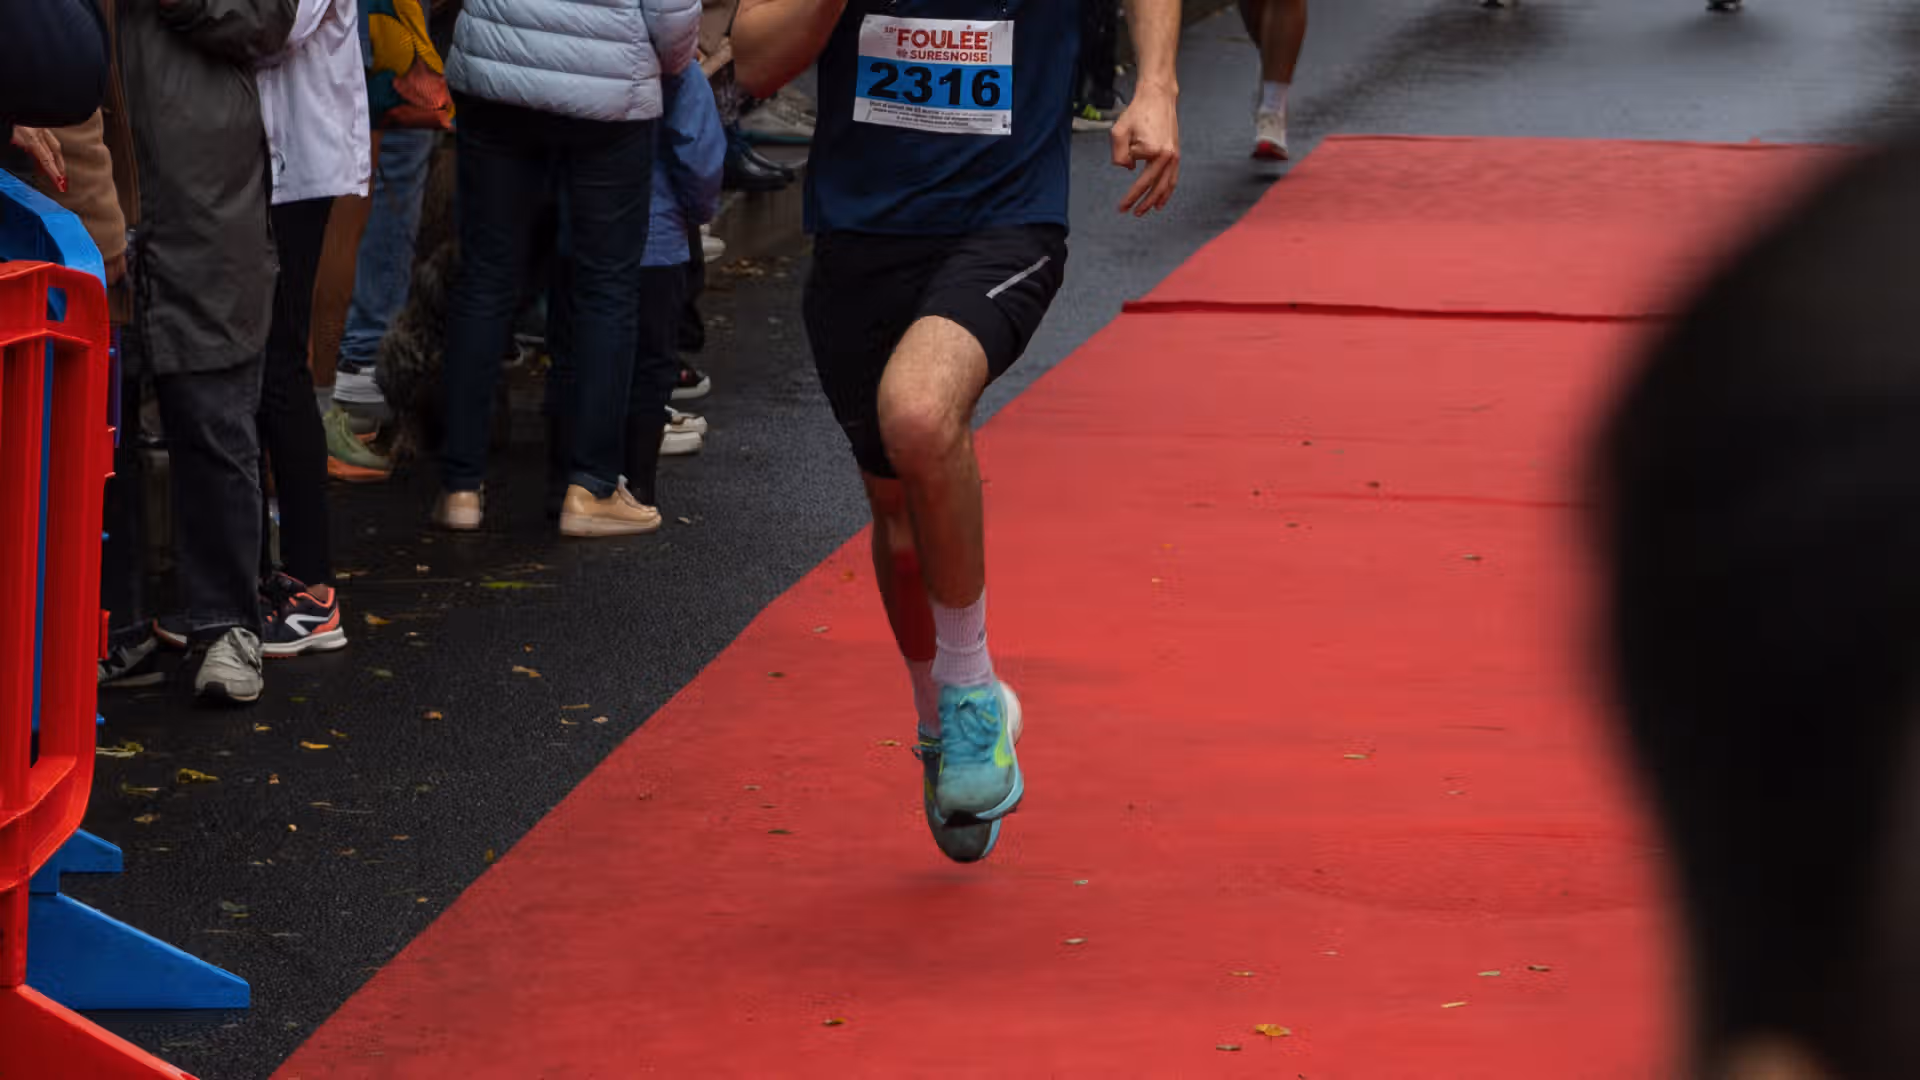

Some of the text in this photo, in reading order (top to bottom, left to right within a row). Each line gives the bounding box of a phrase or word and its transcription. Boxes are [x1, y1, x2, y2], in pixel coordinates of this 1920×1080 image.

[896, 24, 988, 50] FOULÉE
[910, 50, 988, 62] SURESNOISE
[868, 62, 1001, 107] 2316
